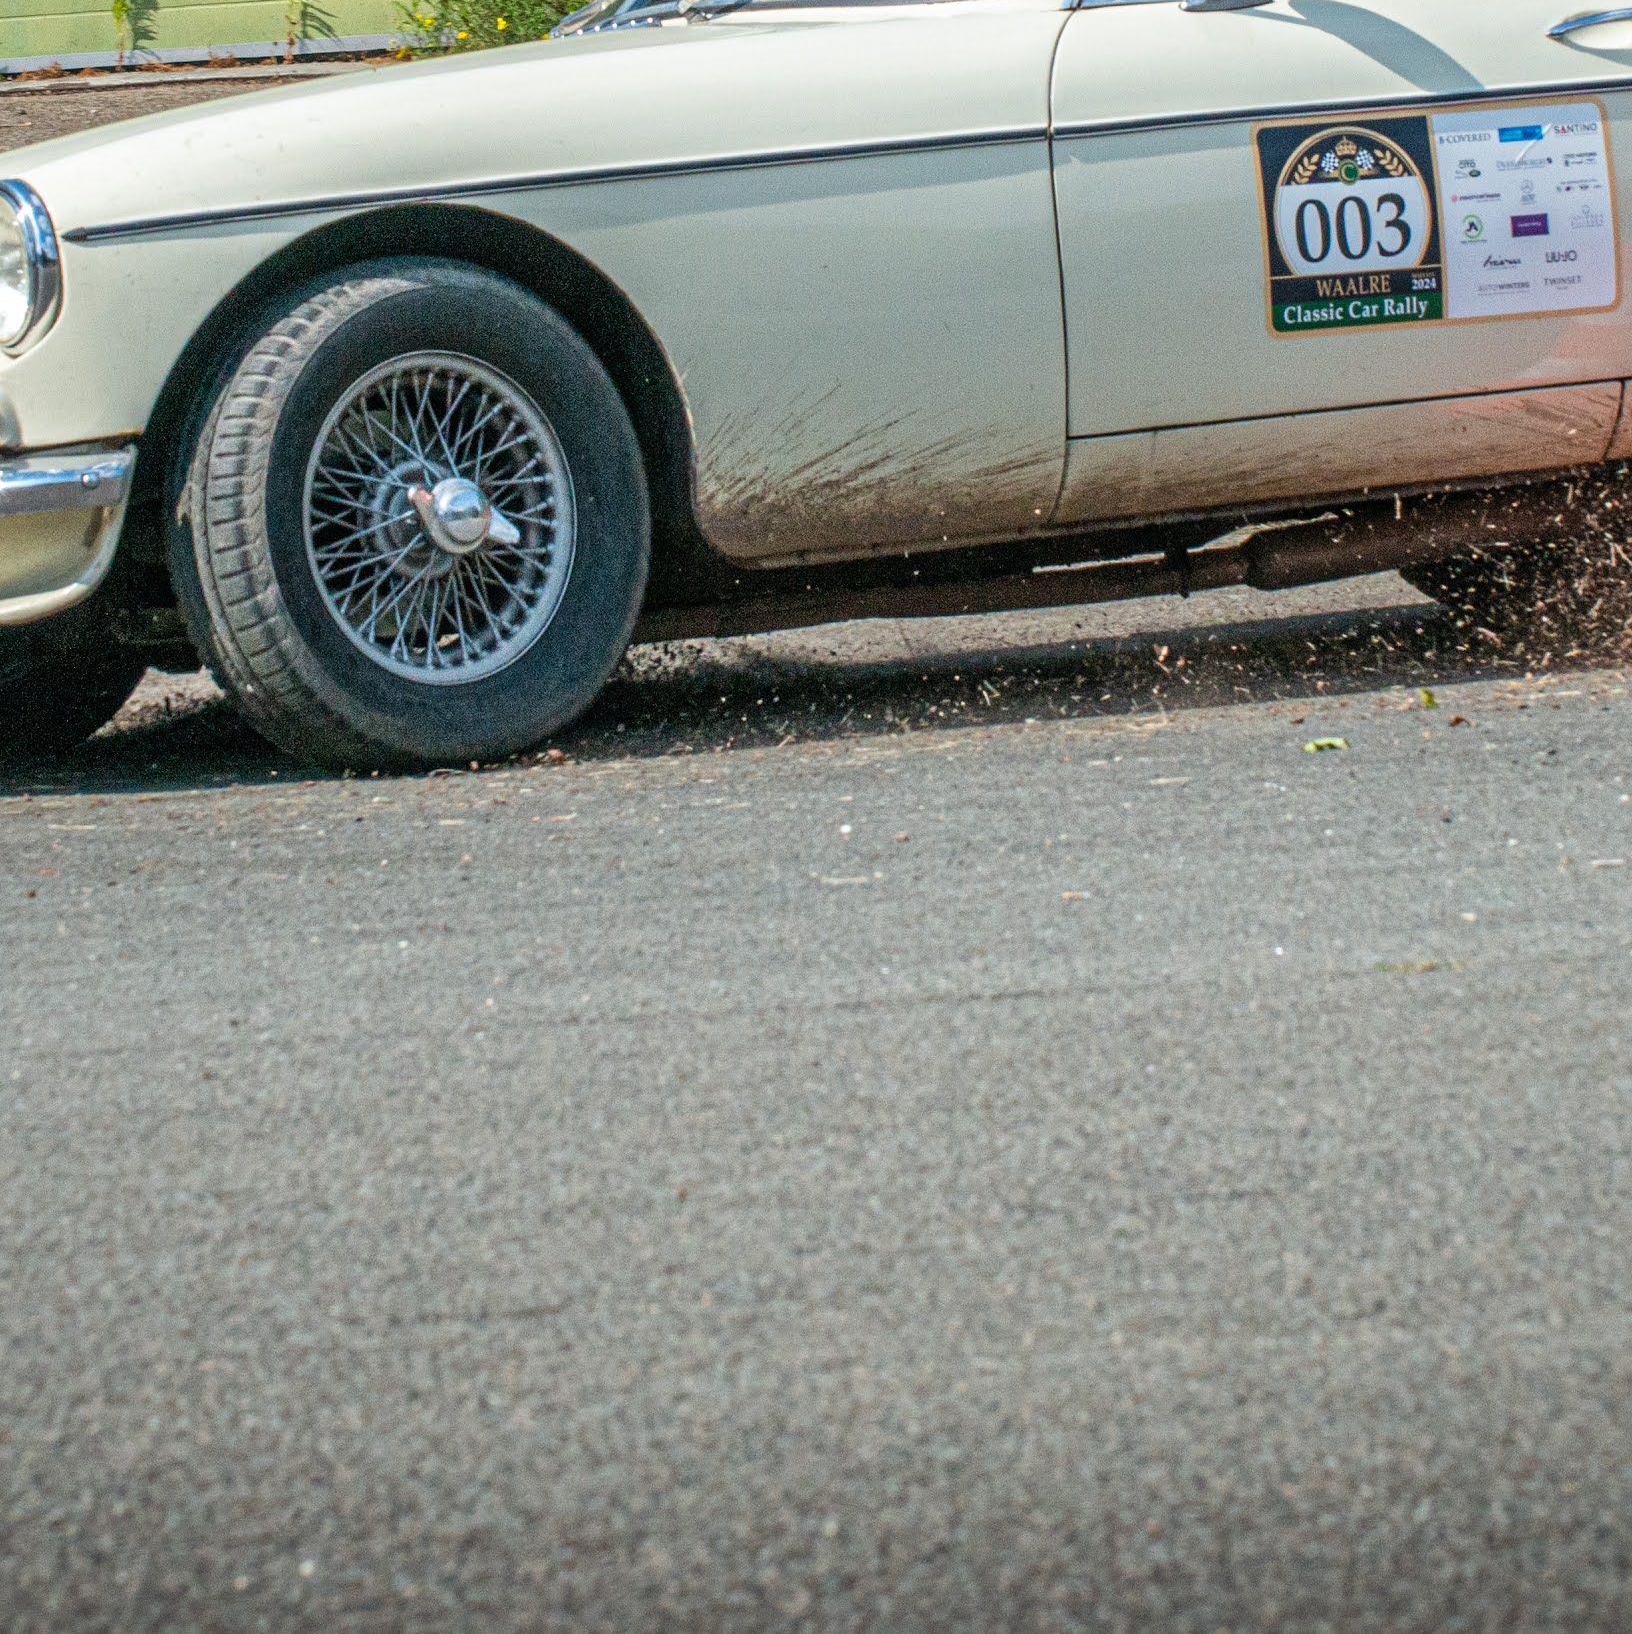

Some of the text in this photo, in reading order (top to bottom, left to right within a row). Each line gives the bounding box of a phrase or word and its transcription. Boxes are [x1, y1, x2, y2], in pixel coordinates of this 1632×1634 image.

[1295, 192, 1412, 263] 003
[1317, 274, 1392, 298] WAALRE
[1411, 277, 1437, 291] 2024
[1283, 296, 1428, 324] Classic Car Rally
